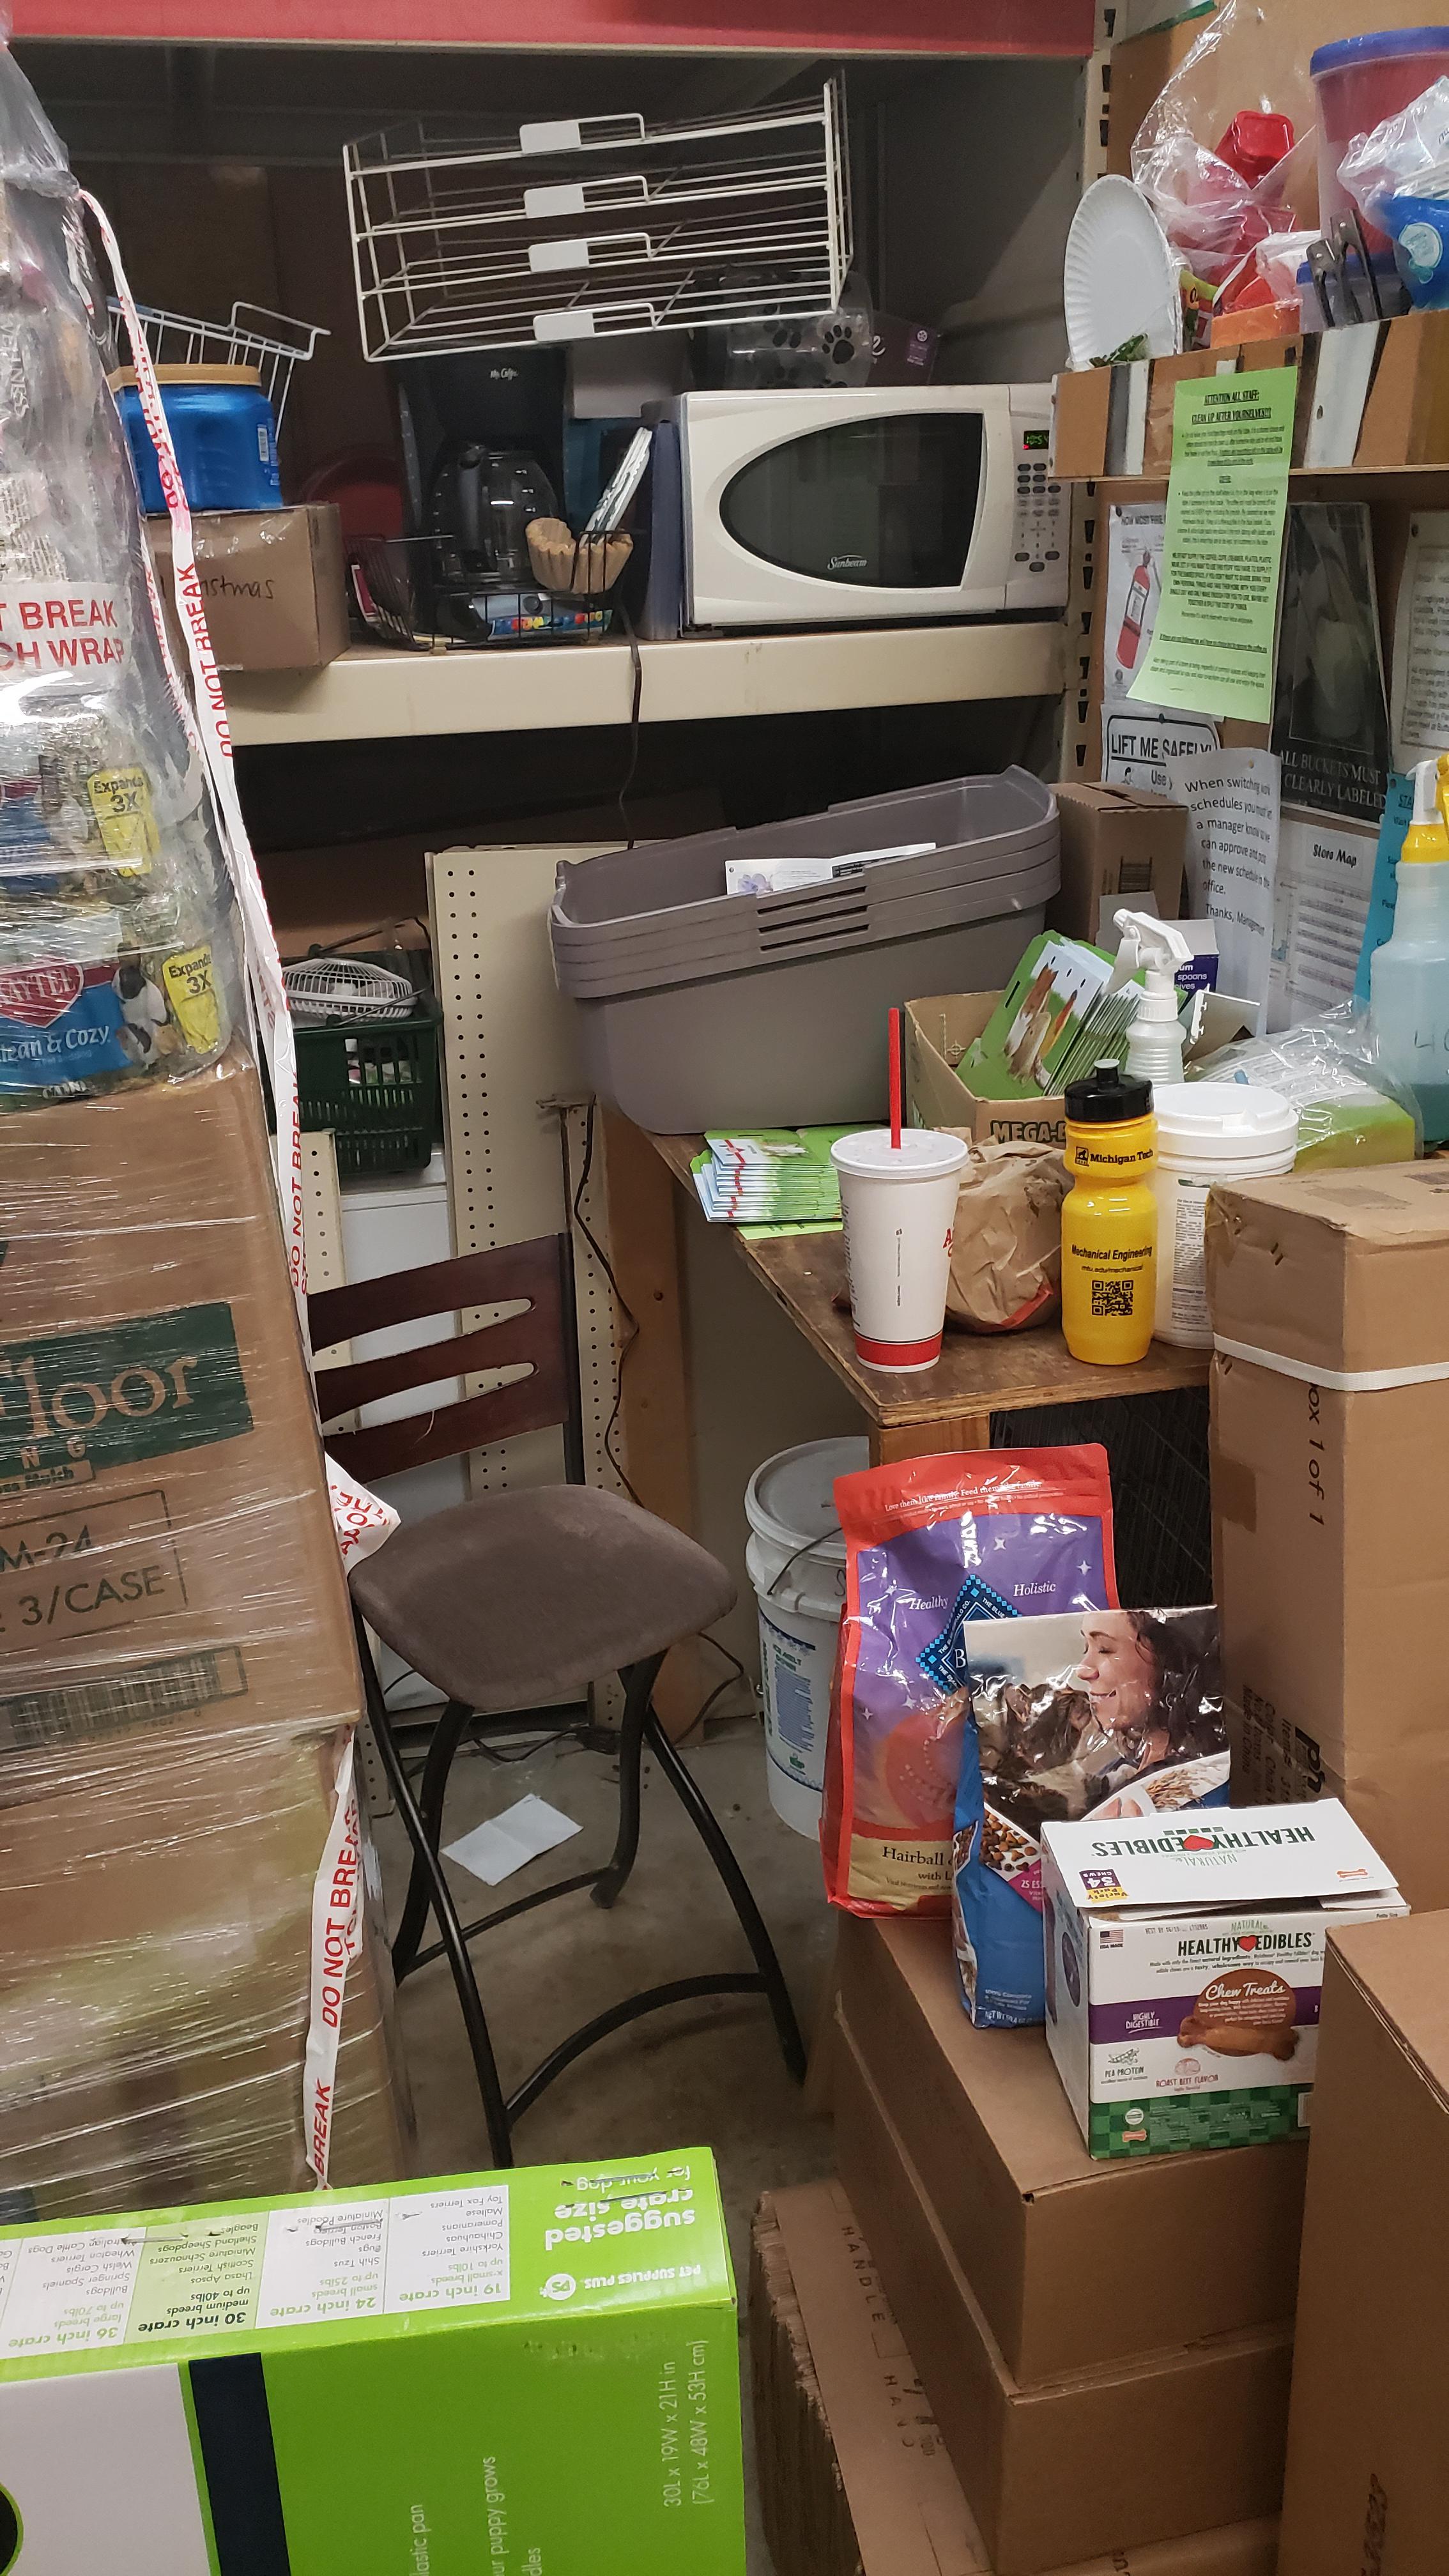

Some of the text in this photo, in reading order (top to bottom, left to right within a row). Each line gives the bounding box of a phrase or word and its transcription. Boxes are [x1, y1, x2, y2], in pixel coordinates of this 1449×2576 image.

[1204, 390, 1259, 406] ATTENTION ALL STAFF:
[1192, 411, 1231, 424] CLEAN UP AFTER
[1121, 516, 1135, 525] HOW
[827, 556, 868, 571] Sunbeam
[19, 599, 118, 630] BREAK
[177, 565, 226, 712] NOT BREAK
[47, 638, 125, 667] WRAP
[1111, 734, 1158, 758] LIFT ME
[1280, 749, 1381, 785] ALL MUST
[1151, 770, 1167, 786] Use
[1184, 779, 1223, 792] When
[1284, 773, 1386, 809] CLEARLY LABELED
[111, 790, 141, 813] 3X
[1190, 797, 1255, 813] schedules you
[1197, 820, 1245, 834] a manager
[1201, 839, 1248, 858] can approve
[1313, 844, 1357, 868] Store Map
[1202, 859, 1234, 875] the new
[1202, 880, 1225, 895] office.
[1206, 903, 1234, 922] Thanks,
[186, 969, 214, 994] 3X
[47, 1025, 109, 1054] & Cozy
[1090, 1148, 1153, 1165] Michigan Tech
[291, 1176, 302, 1238] NOT
[1071, 1243, 1153, 1262] Mechanical Engineering
[1308, 1438, 1326, 1526] 1 of 1
[900, 1499, 917, 1508] them
[961, 1488, 978, 1496] Feed
[19, 1565, 165, 1625] 3/CASE
[1013, 1581, 1056, 1597] Holistic
[909, 1595, 948, 1610] Healthy
[982, 1597, 995, 1608] THE
[938, 1644, 949, 1655] THE
[1091, 1825, 1315, 1857] HEALTHY EDIBLES
[882, 1846, 944, 1866] Hairball
[1181, 1853, 1238, 1866] NATURAL
[918, 1872, 942, 1880] with
[1081, 1869, 1112, 1878] CHEWS
[1087, 1875, 1114, 1888] 34
[1231, 1919, 1264, 1932] NATURAL
[1177, 1932, 1312, 1957] HEALTHY EDIBLES
[322, 1917, 345, 2028] DO NOT
[1205, 1979, 1287, 2000] Chew Treats
[1126, 2018, 1160, 2030] DIGESTIBLE
[1133, 2011, 1155, 2021] HIGHLY
[1105, 2066, 1144, 2078] PEA PROTEIN
[1156, 2079, 1177, 2088] ROAST
[1194, 2074, 1218, 2084] FLAVOR
[314, 2078, 330, 2177] BREAK
[576, 2165, 691, 2194] for your dog
[430, 2195, 503, 2211] Toy Fox Terriers
[554, 2187, 694, 2222] crate size
[337, 2210, 383, 2223] Miniature
[466, 2207, 503, 2219] Maltese
[220, 2223, 258, 2235] Beagles
[441, 2219, 503, 2232] Pomeranians
[544, 2209, 695, 2251] suggested
[28, 2242, 85, 2255] Cattle Dogs
[158, 2235, 257, 2254] Shetland Sheepdogs
[305, 2233, 382, 2249] French Bulldogs
[150, 2246, 256, 2266] Miniature Schnauzers
[422, 2242, 503, 2259] Yorkshire Terriers
[51, 2254, 85, 2265] Terriers
[66, 2261, 132, 2274] Welsh Corgis
[178, 2259, 254, 2274] Scottish Terriers
[334, 2257, 379, 2270] Shih Tzus
[448, 2262, 475, 2273] 10lbs
[489, 2257, 503, 2267] up
[42, 2273, 130, 2290] Springer Spaniels
[190, 2271, 252, 2285] Lhasa Apsos
[319, 2271, 379, 2288] up to 25lbs
[431, 2269, 503, 2286] x-small breeds
[584, 2264, 701, 2289] PET SUPPLIES PLUS
[841, 2224, 887, 2324] HANDLE
[86, 2285, 128, 2297] Bulldogs
[190, 2286, 250, 2302] up to 40lbs
[311, 2283, 379, 2301] small breeds
[398, 2283, 502, 2304] 19 inch crate
[63, 2301, 125, 2317] up to 70lbs
[167, 2299, 249, 2316] medium breeds
[269, 2296, 376, 2319] 24 inch crate
[54, 2312, 121, 2329] large breeds
[137, 2312, 247, 2333] 30 inch crate
[8, 2327, 118, 2349] 36 inch crate
[686, 2340, 709, 2366] cm)
[659, 2362, 675, 2374] in
[688, 2371, 707, 2400] 53H
[659, 2379, 677, 2410] 21H
[661, 2428, 678, 2462] 19W
[690, 2420, 708, 2456] 48W
[668, 2468, 680, 2476] x
[663, 2481, 682, 2507] 30L
[692, 2474, 714, 2504] (76L
[482, 2457, 509, 2554] puppy grows
[410, 2504, 432, 2533] pan
